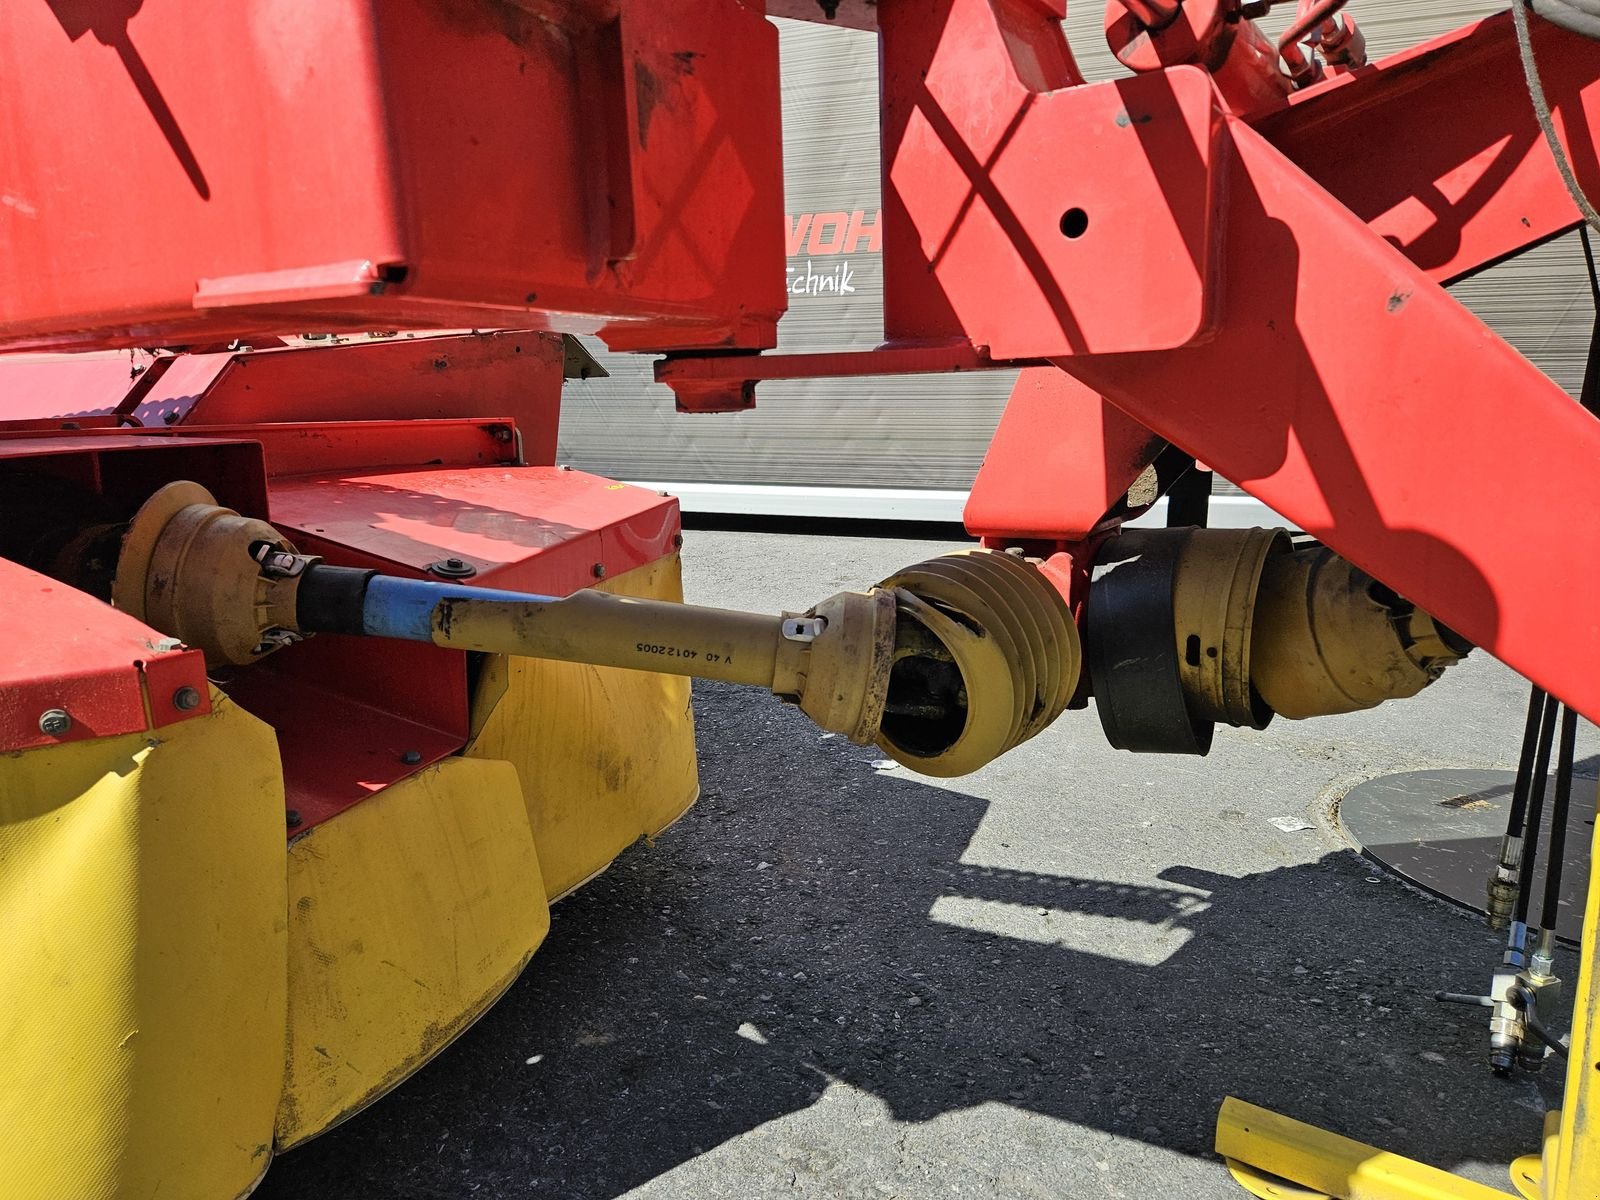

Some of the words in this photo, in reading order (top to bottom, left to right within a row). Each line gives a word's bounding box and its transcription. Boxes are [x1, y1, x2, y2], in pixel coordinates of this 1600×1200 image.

[636, 643, 698, 659] 40122005
[706, 652, 720, 662] 40
[724, 656, 732, 665] V
